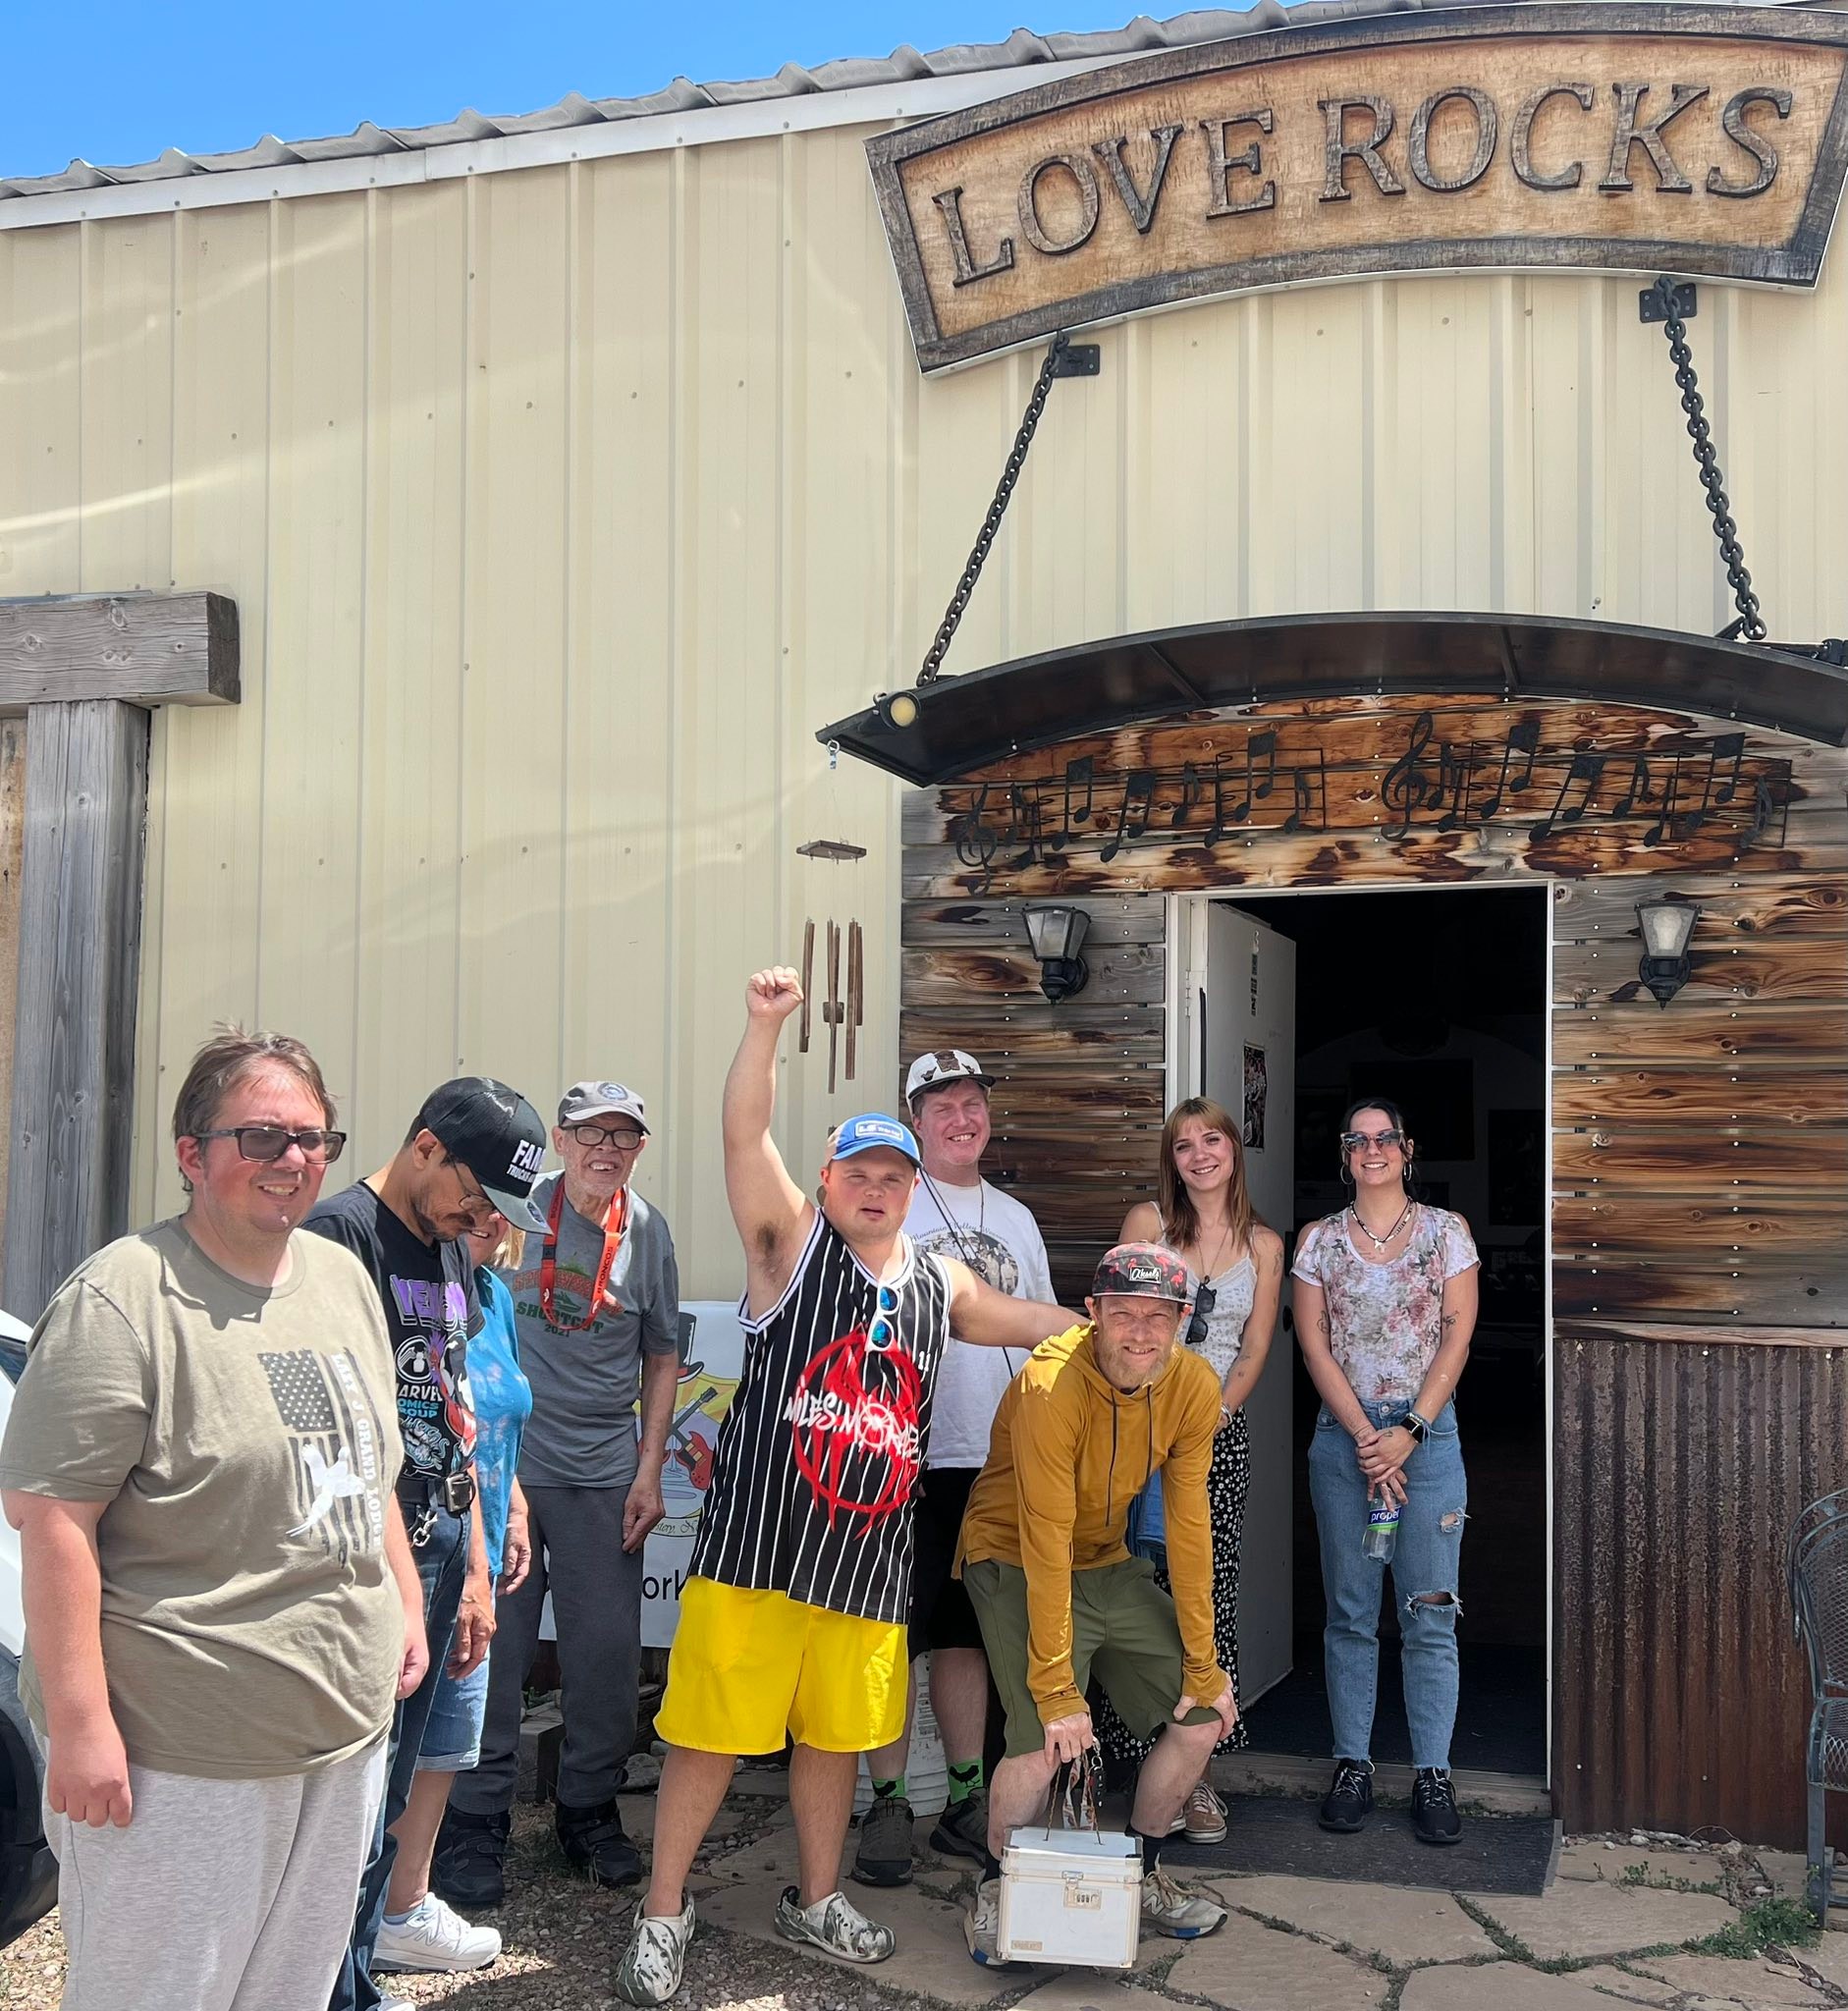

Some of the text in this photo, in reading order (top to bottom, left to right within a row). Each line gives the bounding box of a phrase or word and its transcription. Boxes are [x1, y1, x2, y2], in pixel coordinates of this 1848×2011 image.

[932, 82, 1794, 288] LOVE ROCKS
[395, 1384, 443, 1402] ARVEL
[397, 1397, 440, 1410] OMICS
